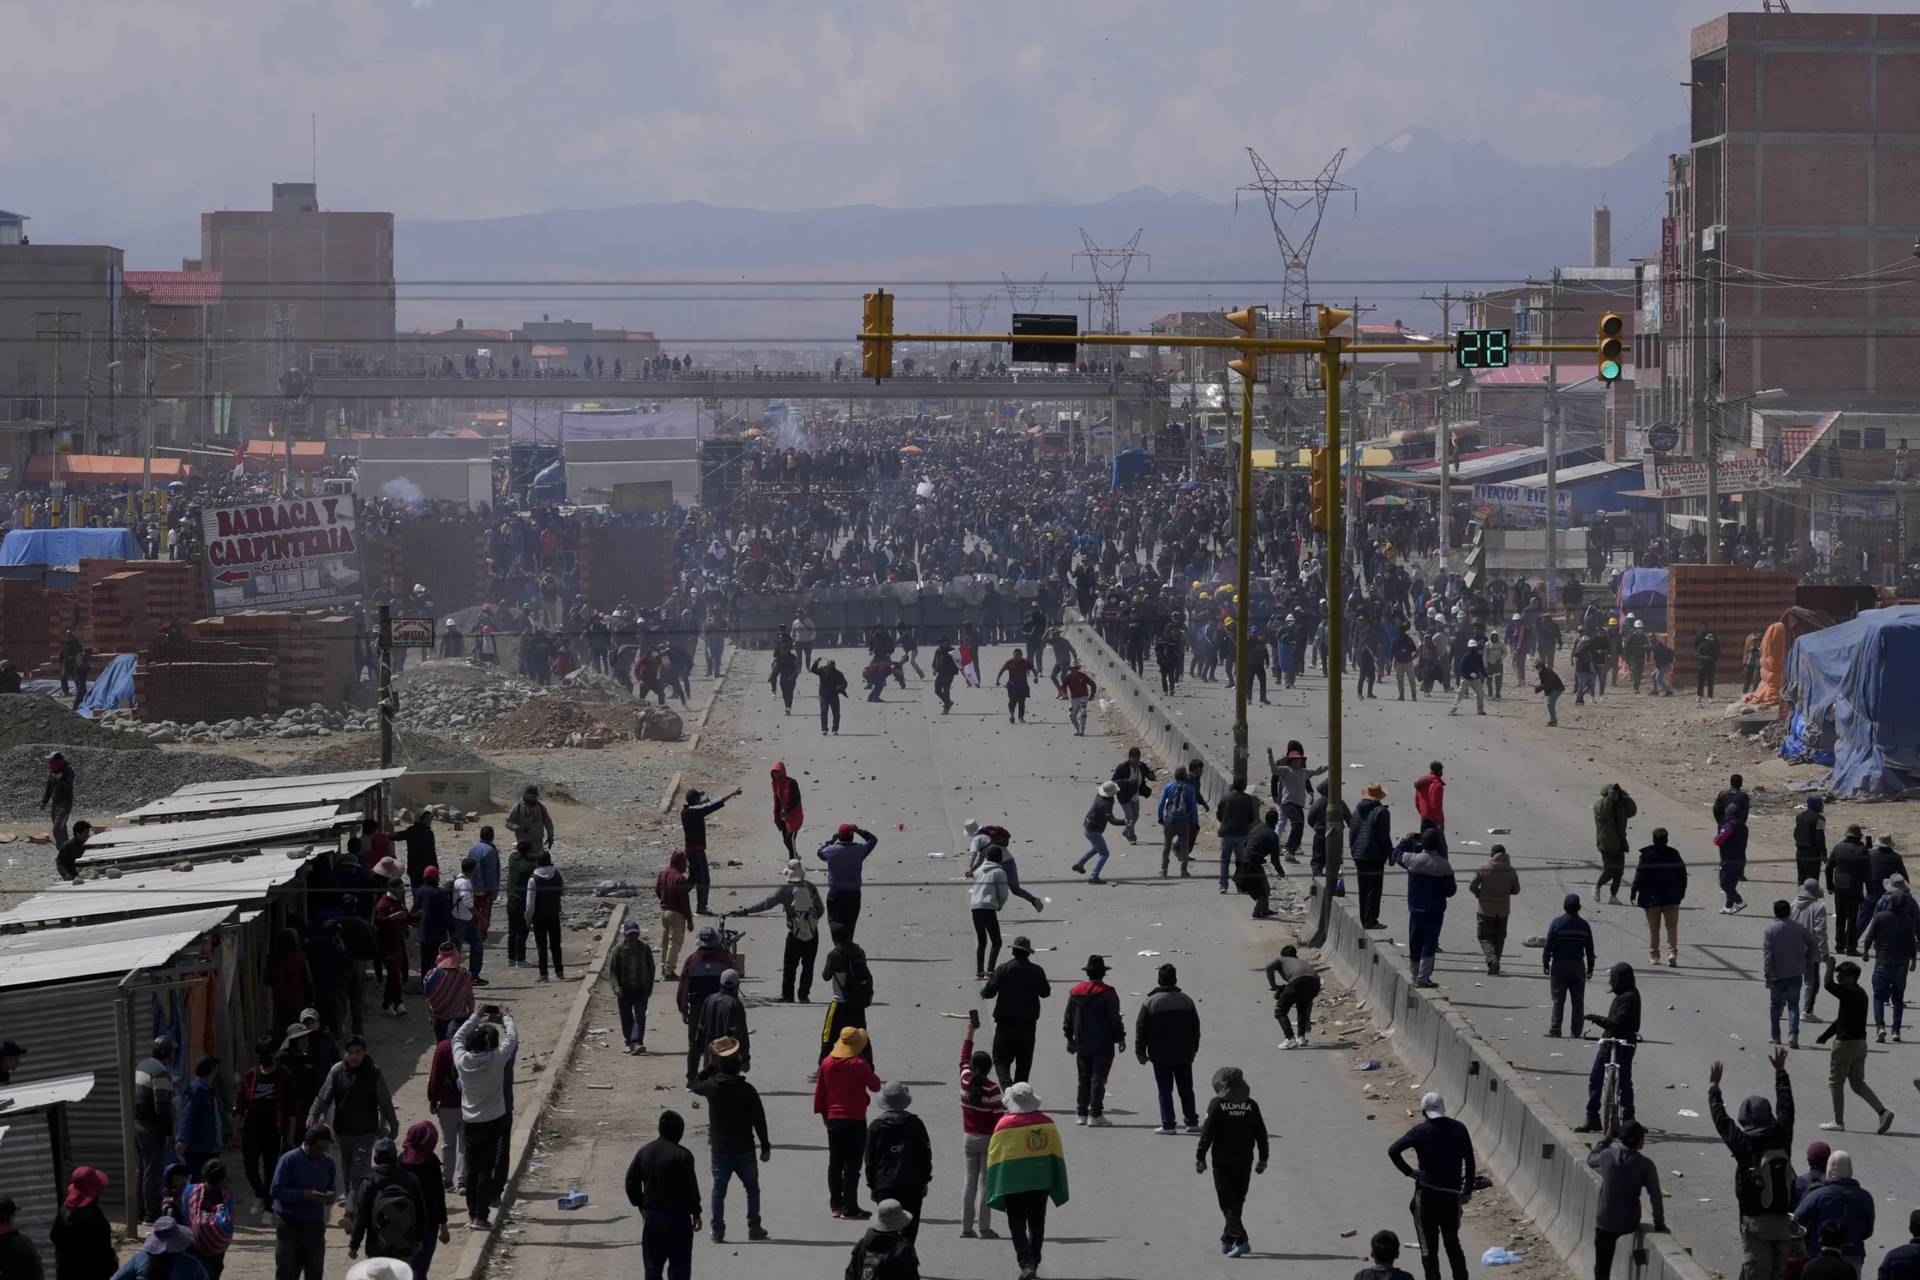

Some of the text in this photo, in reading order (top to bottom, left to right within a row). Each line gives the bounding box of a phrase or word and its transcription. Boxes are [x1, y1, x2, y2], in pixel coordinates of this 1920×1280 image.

[1663, 220, 1673, 322] ALOJAMIENTO
[1460, 330, 1507, 367] 28
[1474, 486, 1520, 501] EVENTOS
[216, 498, 338, 537] BARRACA Y
[209, 526, 356, 567] CARPINTERIA
